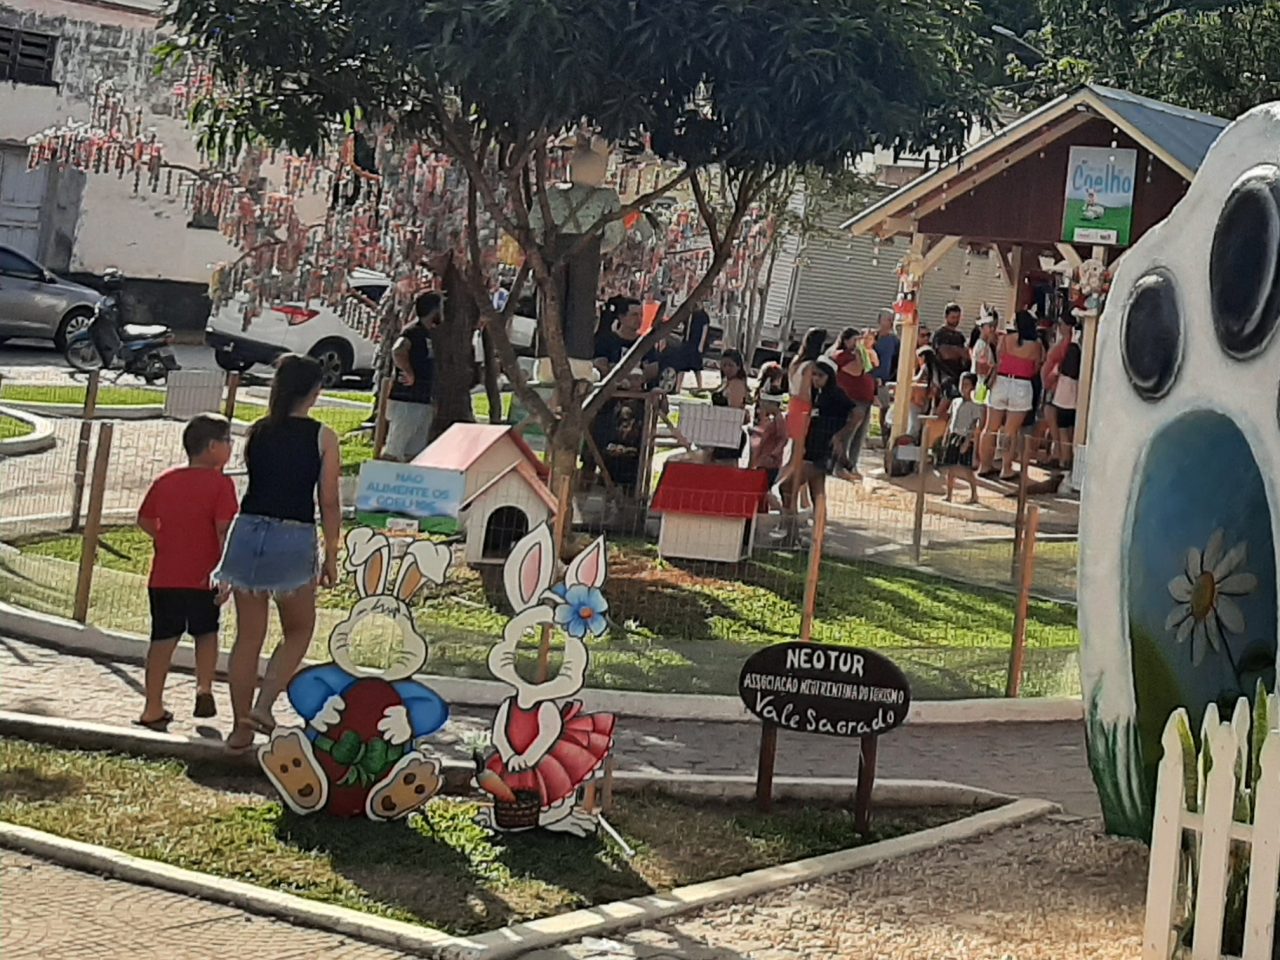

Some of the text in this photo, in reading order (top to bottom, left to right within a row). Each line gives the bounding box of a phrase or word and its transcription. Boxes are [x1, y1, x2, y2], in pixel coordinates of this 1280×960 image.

[1073, 164, 1131, 193] Coelho
[366, 482, 450, 499] ALIMENTE OS
[786, 648, 864, 676] NEOTUR
[755, 691, 895, 735] Vale Sagrado
